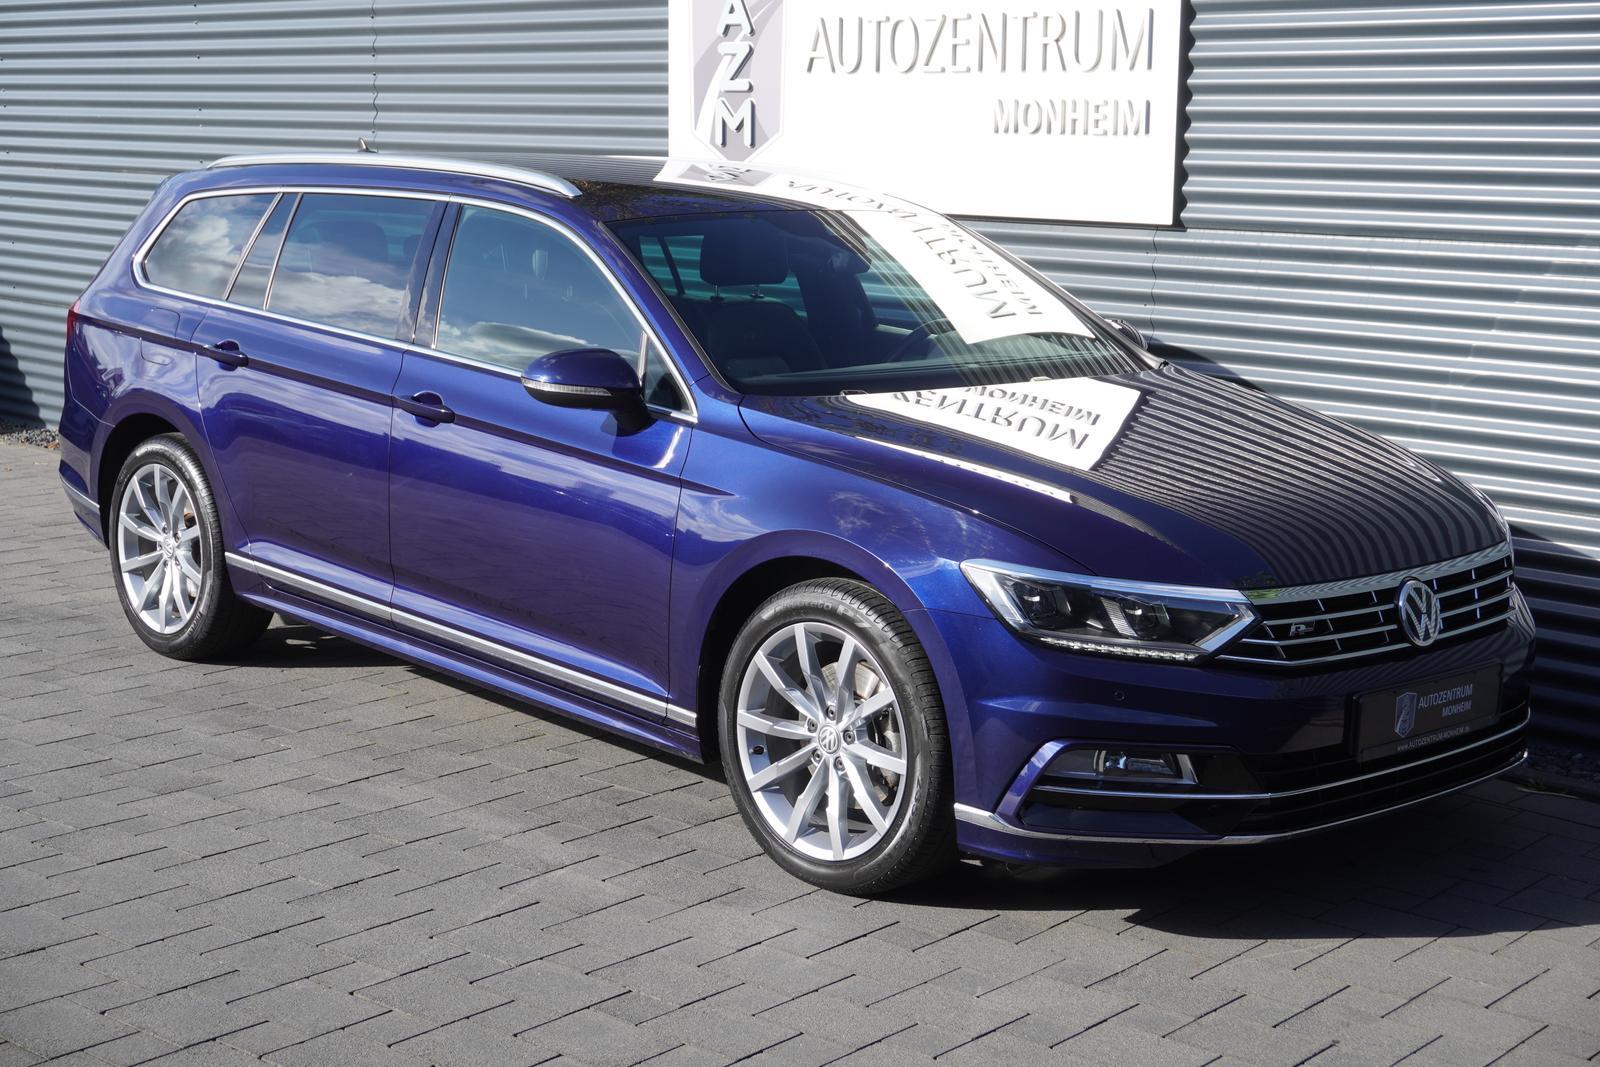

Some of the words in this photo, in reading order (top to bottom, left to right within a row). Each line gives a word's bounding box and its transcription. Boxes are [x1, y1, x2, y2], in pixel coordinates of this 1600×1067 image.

[806, 8, 1154, 74] AUTOZENTRUM
[993, 99, 1152, 137] MONHEIM
[1417, 683, 1473, 709] AUTOZENTRUM
[1441, 700, 1472, 717] MONHEIM
